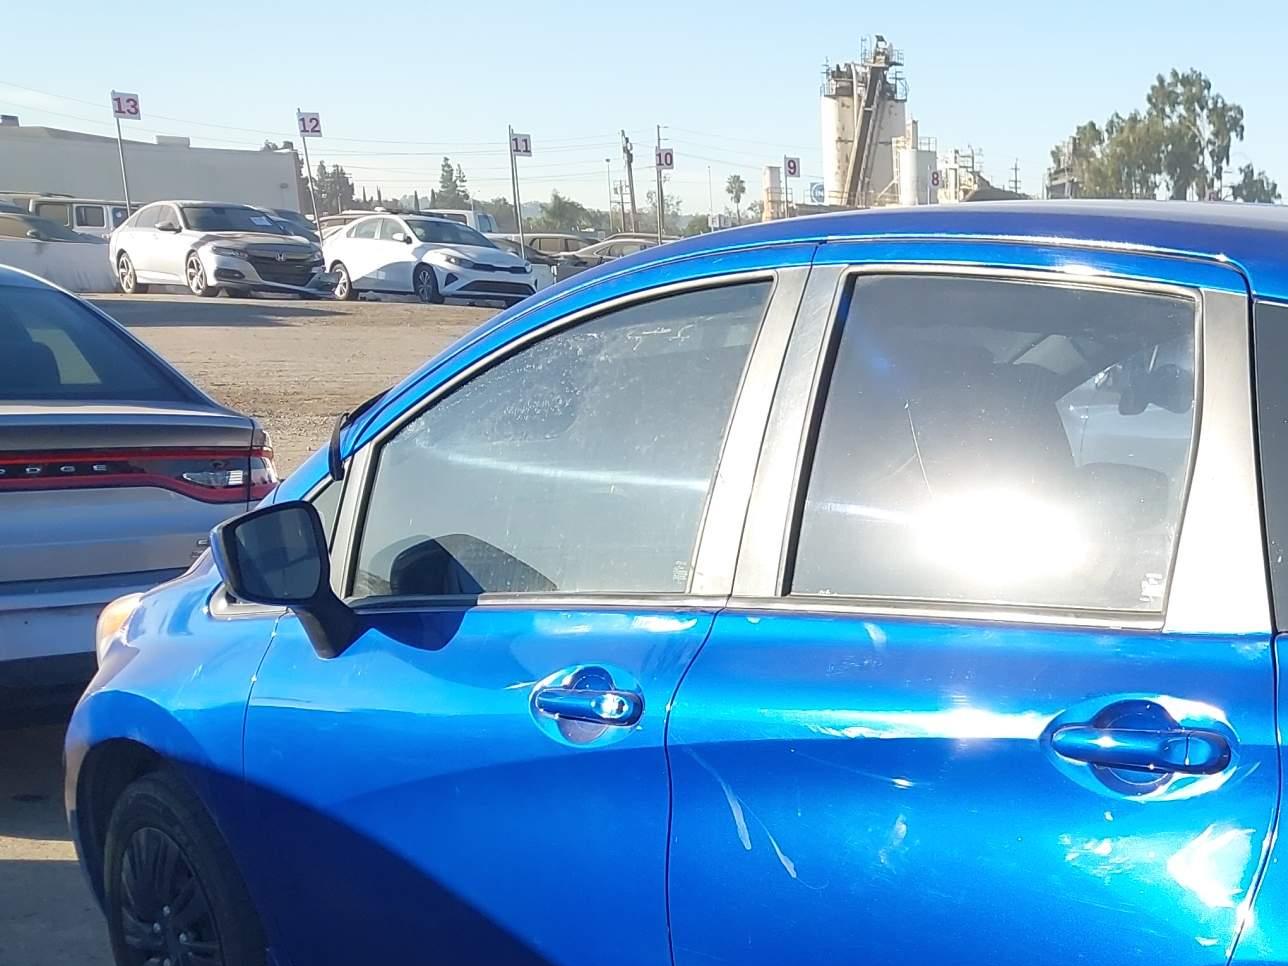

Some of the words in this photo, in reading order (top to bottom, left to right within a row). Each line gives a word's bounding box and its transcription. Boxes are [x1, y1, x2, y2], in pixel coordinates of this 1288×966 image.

[113, 97, 138, 115] 13
[298, 117, 321, 133] 12
[511, 137, 531, 153] 11
[656, 152, 673, 166] 10
[787, 159, 797, 175] 9
[931, 171, 940, 186] 8
